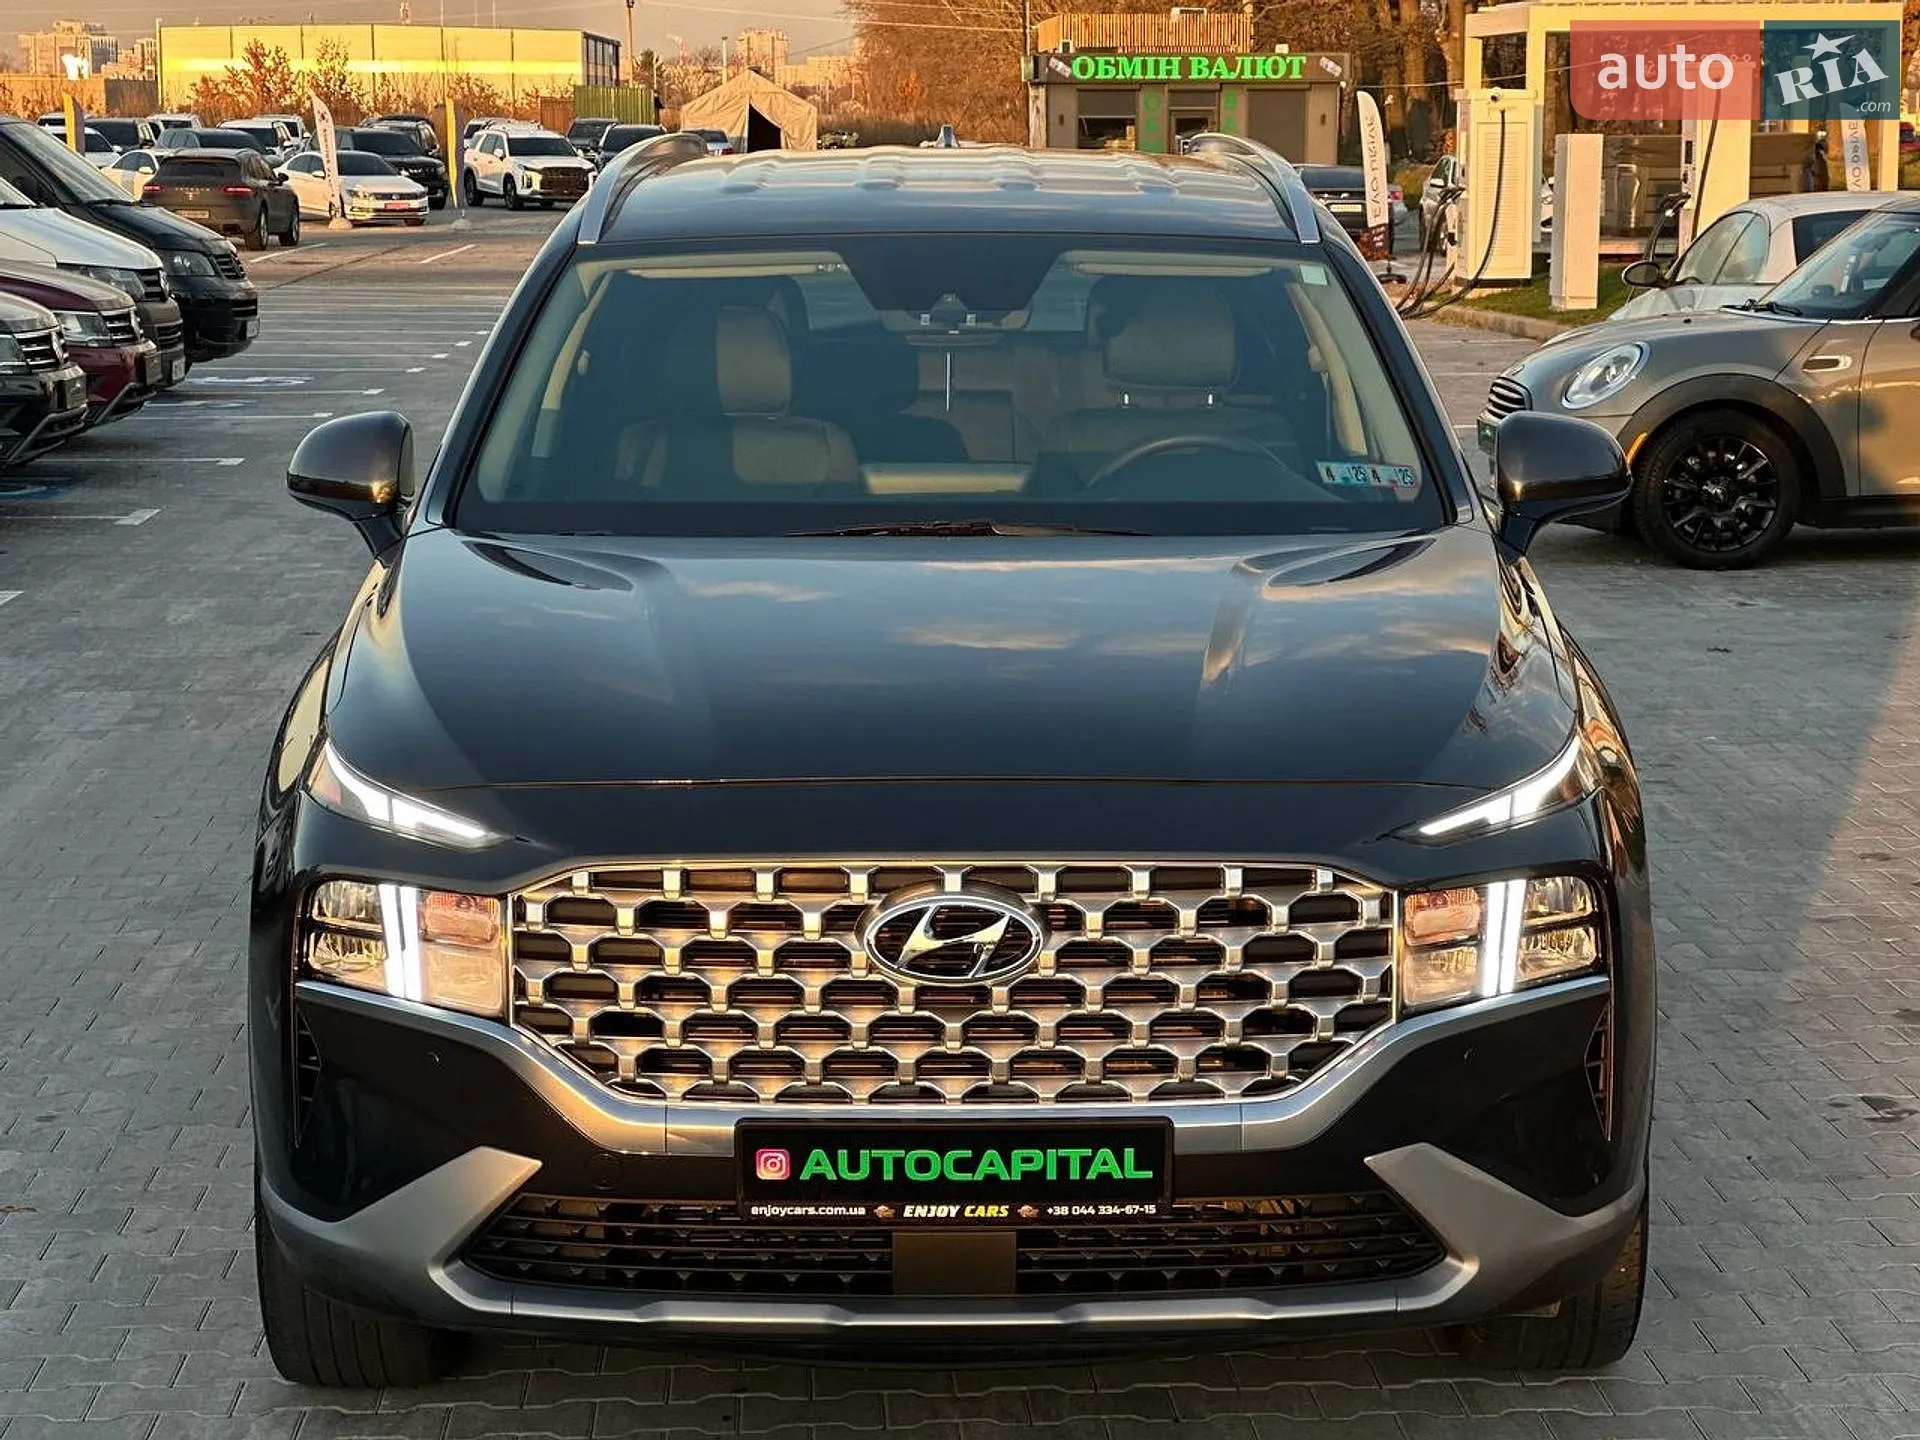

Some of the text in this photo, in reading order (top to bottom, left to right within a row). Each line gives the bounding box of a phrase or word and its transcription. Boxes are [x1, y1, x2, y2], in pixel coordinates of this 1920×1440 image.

[1071, 56, 1307, 80] ОБМІН ВАЛЮТ
[799, 1148, 1153, 1180] AUTOCAPITAL
[751, 1204, 866, 1217] enjoycars.com.ua
[903, 1205, 1009, 1218] ENJOY CARS
[1047, 1204, 1157, 1215] +38 044 334-67-15
